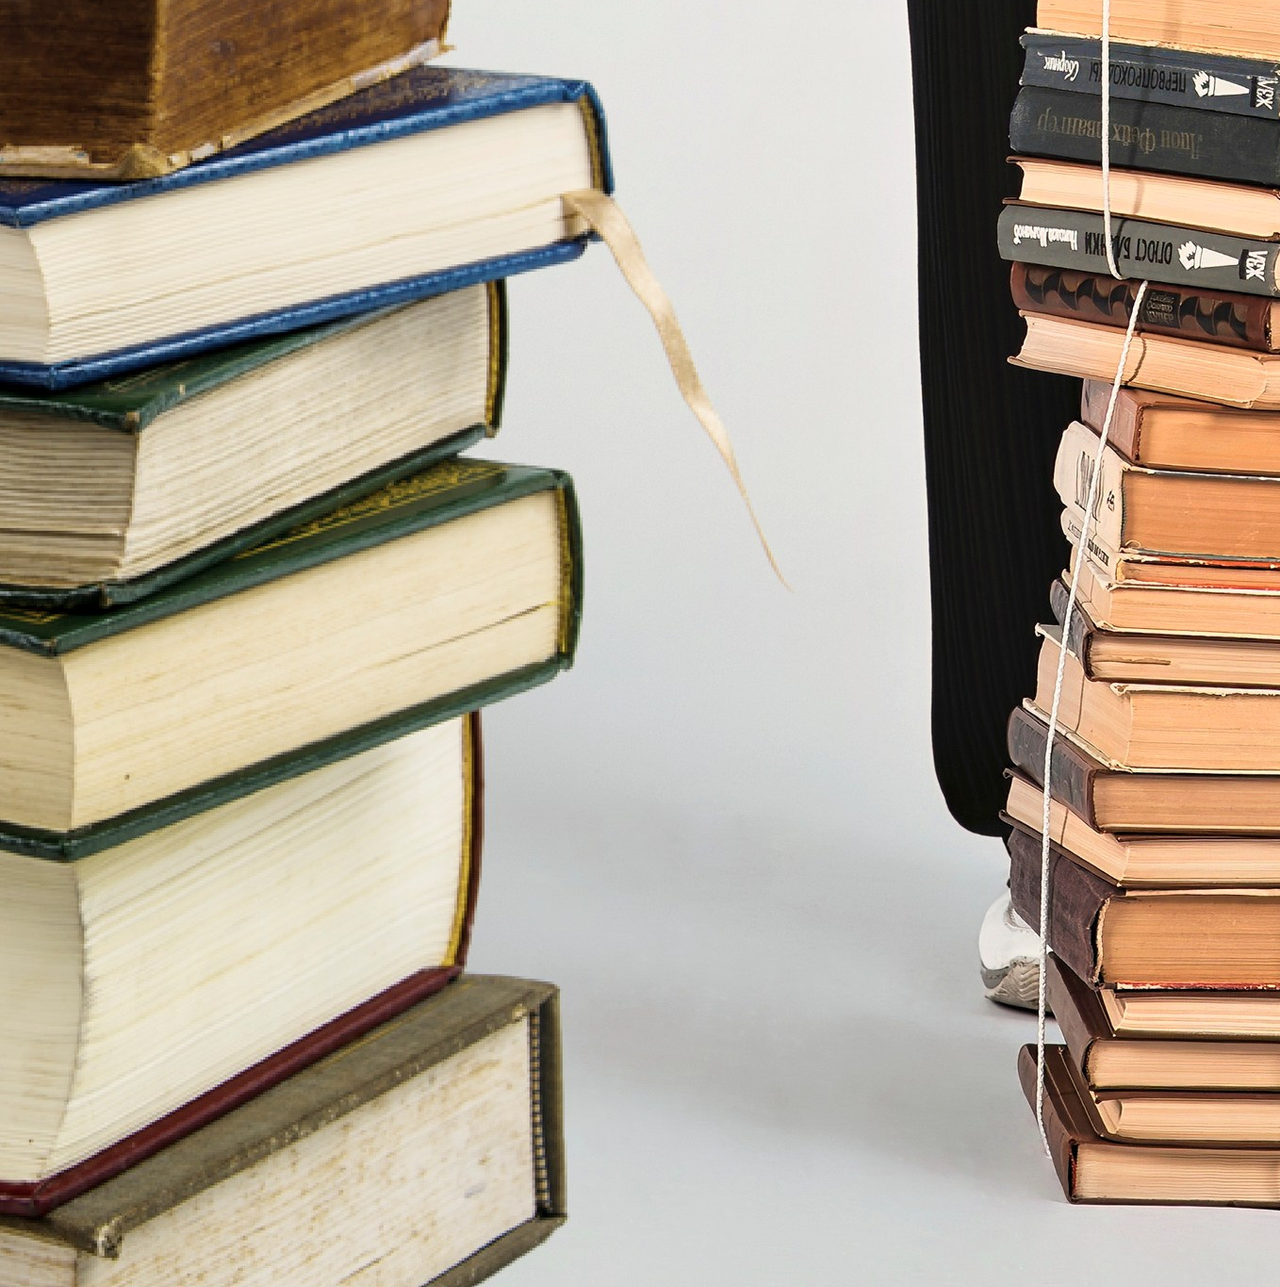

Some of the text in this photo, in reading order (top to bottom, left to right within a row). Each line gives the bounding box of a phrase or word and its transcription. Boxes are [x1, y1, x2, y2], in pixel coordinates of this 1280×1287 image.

[1043, 50, 1080, 82] Сборник
[1089, 61, 1187, 93] ПЕРВОПРОХОДЫ
[1160, 129, 1202, 159] Лион
[1135, 237, 1173, 265] ОГЮСТ
[1246, 249, 1269, 282] ЖЗЛ
